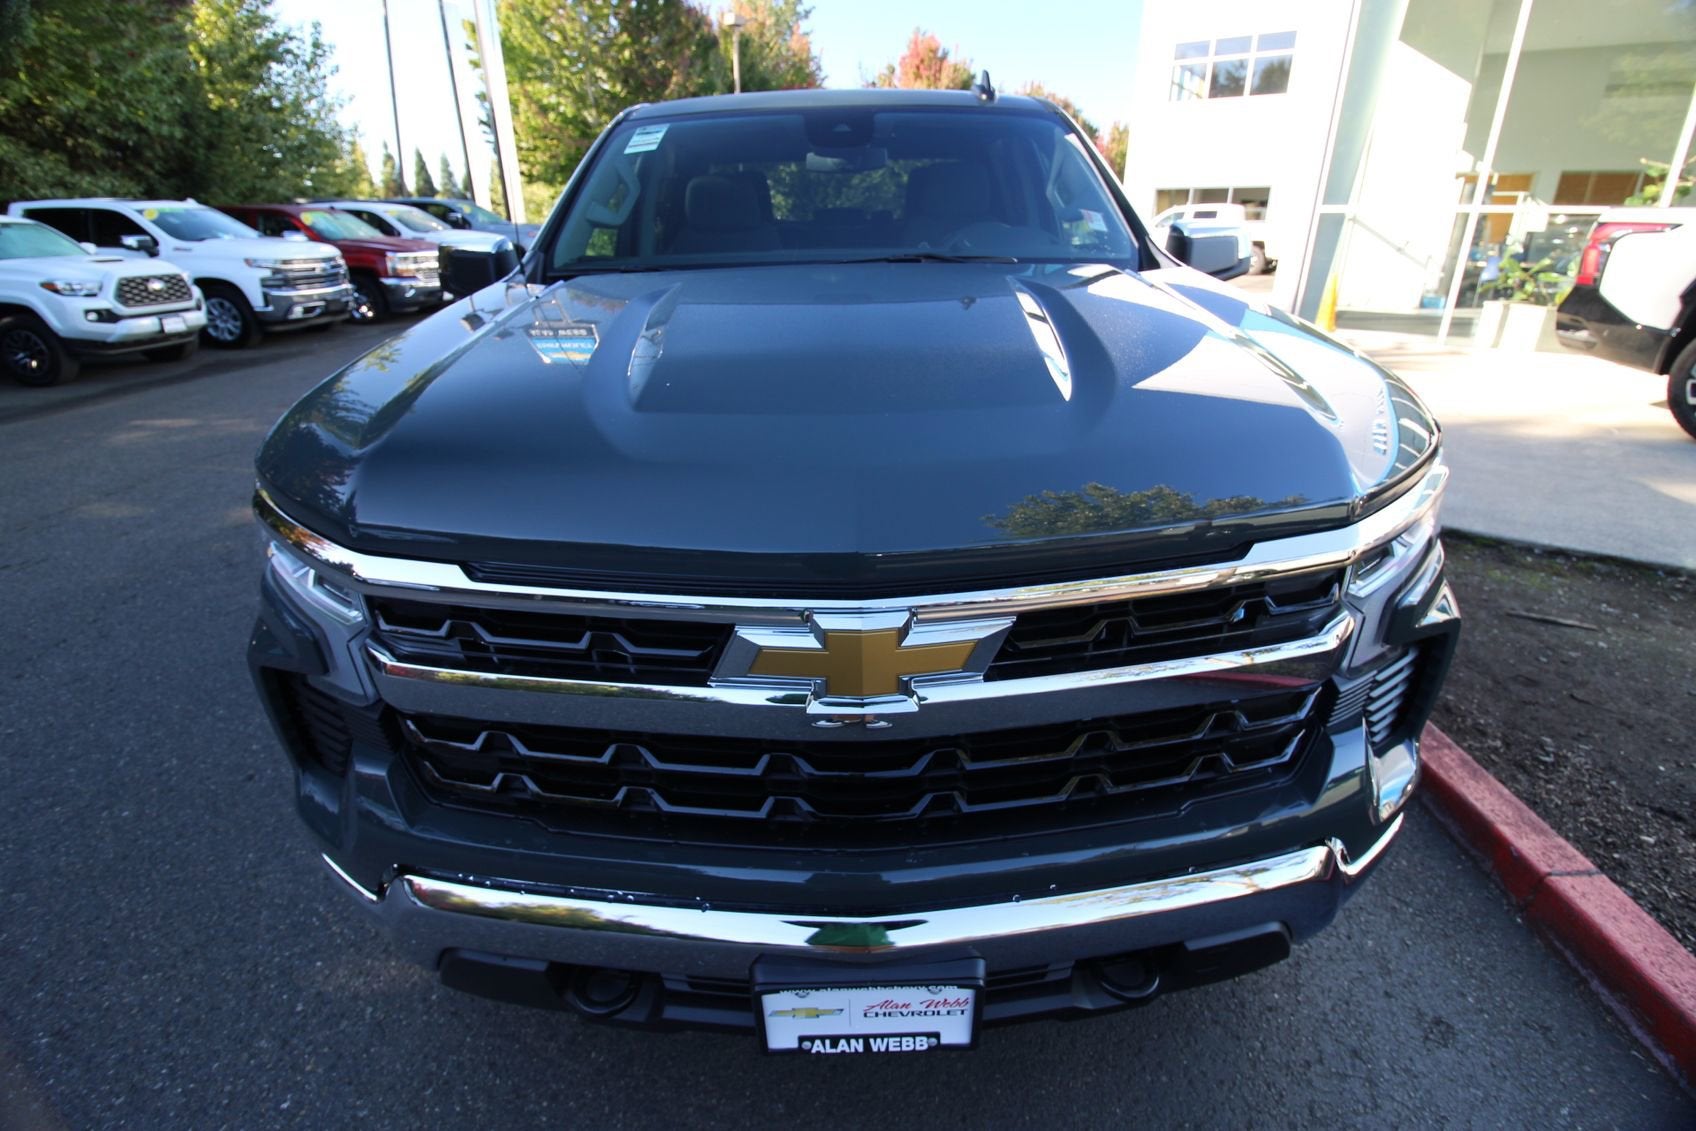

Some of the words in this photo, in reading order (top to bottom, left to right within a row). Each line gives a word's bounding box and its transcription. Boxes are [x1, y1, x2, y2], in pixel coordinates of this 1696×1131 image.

[864, 999, 911, 1010] Alan
[919, 997, 970, 1009] Webb
[864, 1009, 968, 1018] CHEVROLET
[811, 1038, 864, 1054] ALAN
[869, 1036, 929, 1052] WEBB
